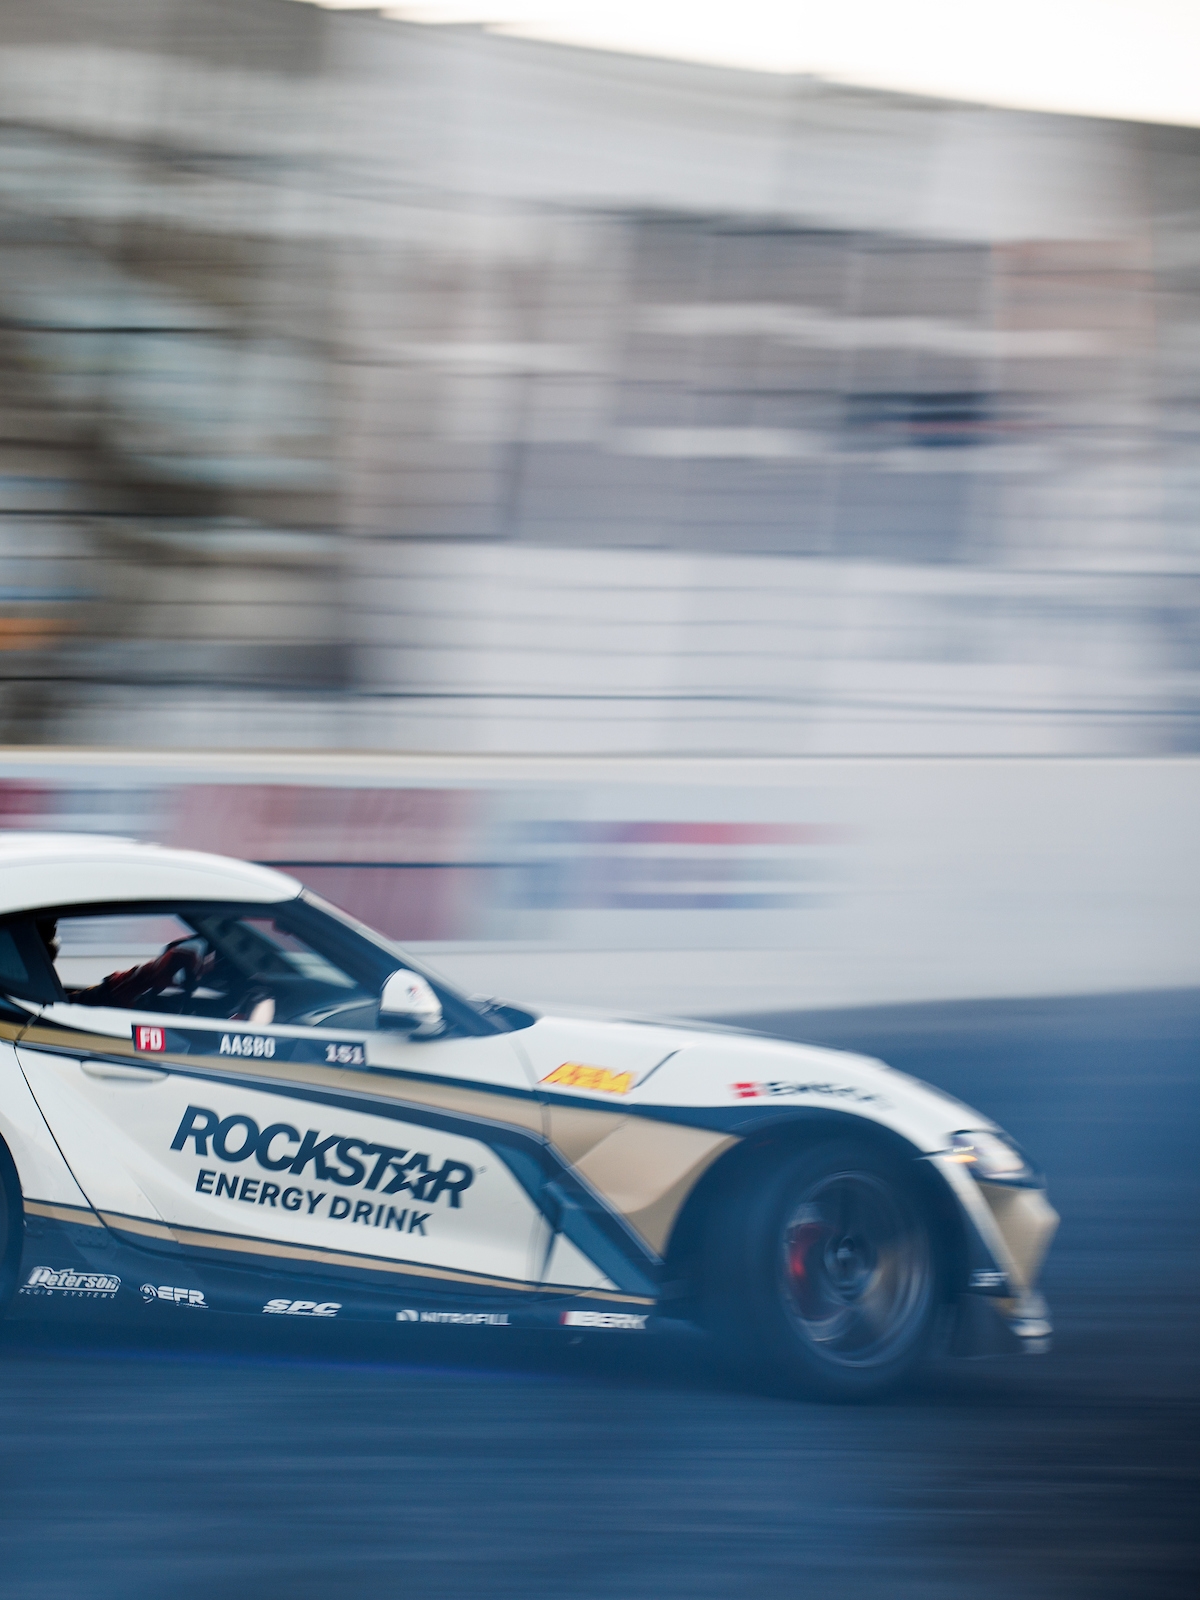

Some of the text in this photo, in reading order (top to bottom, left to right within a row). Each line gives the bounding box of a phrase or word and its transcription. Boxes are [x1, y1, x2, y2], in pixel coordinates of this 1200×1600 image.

[140, 1027, 163, 1050] FD
[325, 1043, 365, 1065] 151
[170, 1104, 476, 1209] ROCKSTAR
[195, 1169, 433, 1236] ENERGY DRINK
[62, 1290, 117, 1300] SYSTEMS
[157, 1285, 207, 1306] EFR
[263, 1299, 343, 1314] SPC
[420, 1311, 512, 1326] NITROFILL
